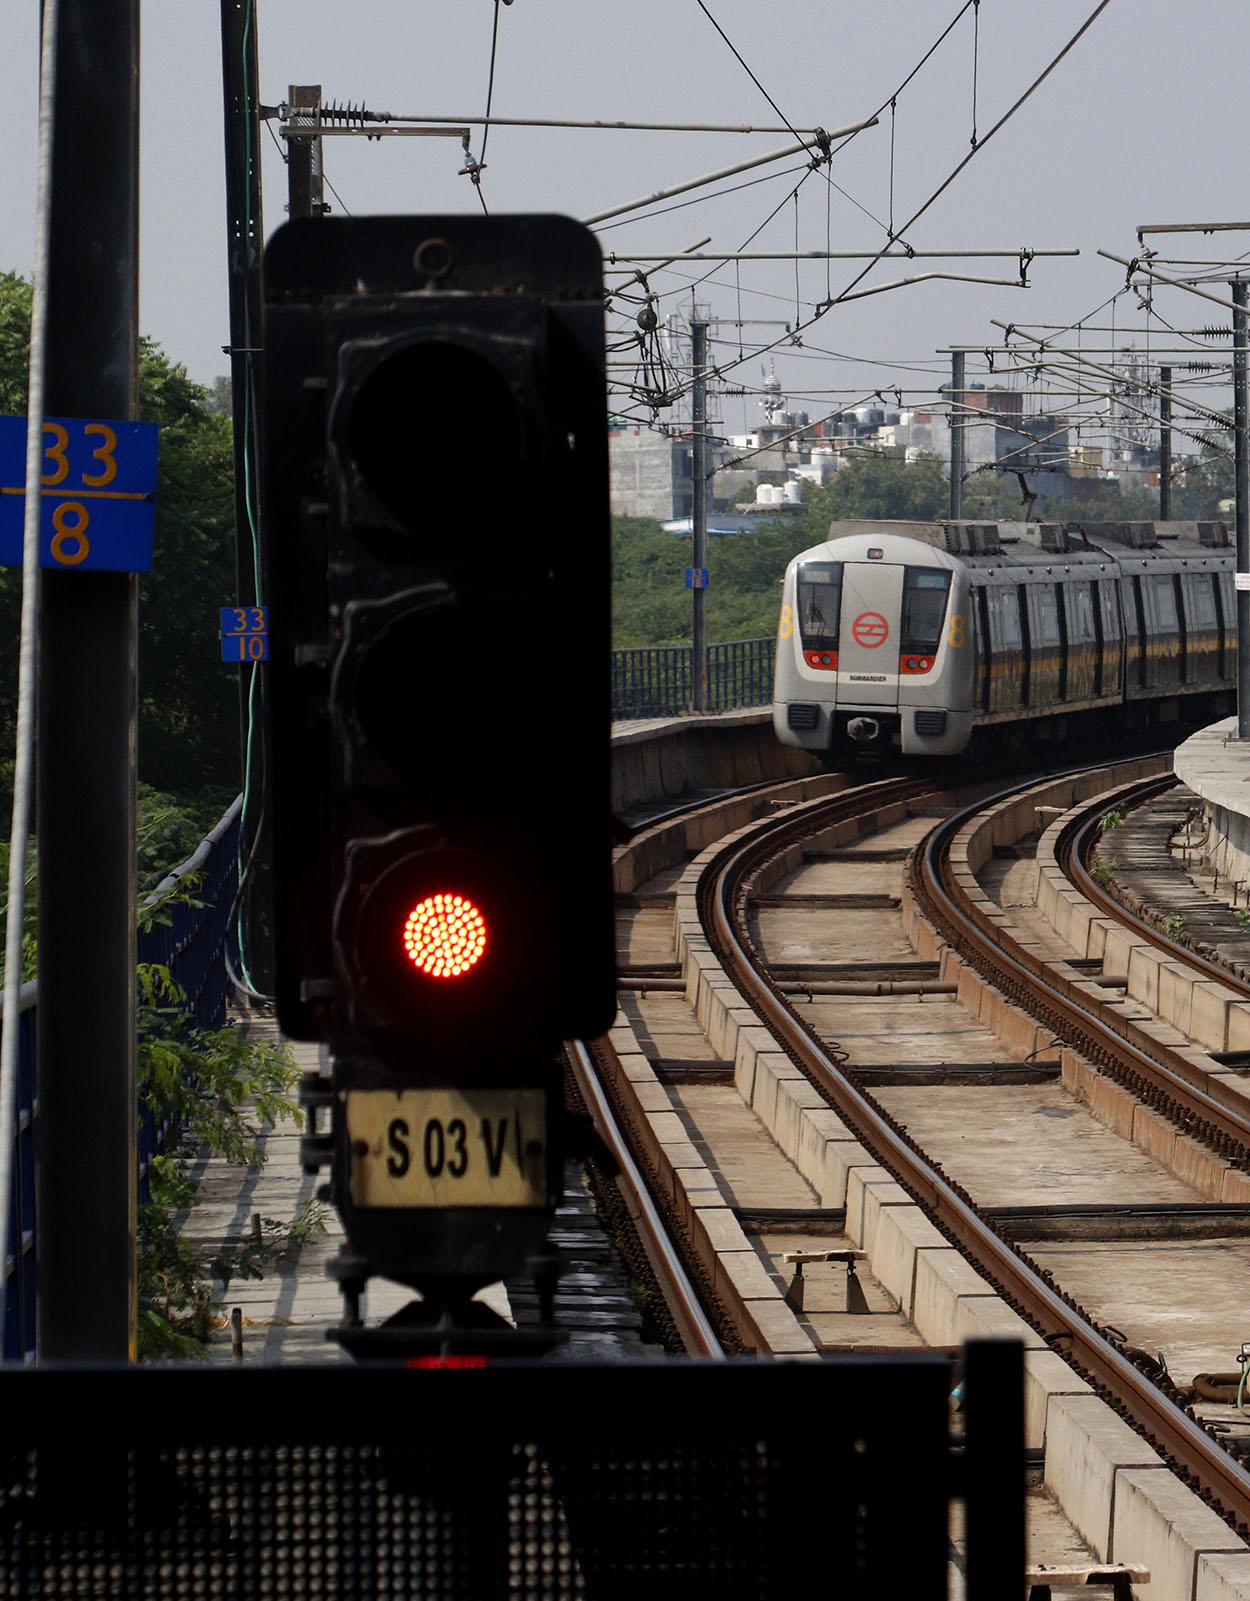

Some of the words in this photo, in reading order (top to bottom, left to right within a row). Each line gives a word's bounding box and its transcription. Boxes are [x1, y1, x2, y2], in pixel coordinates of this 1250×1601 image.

[40, 423, 117, 486] 33
[50, 501, 90, 565] 8
[233, 608, 265, 632] 33
[949, 614, 965, 648] 8
[239, 636, 264, 660] 10
[850, 674, 887, 683] BOMBARDIER
[387, 1118, 410, 1178] S
[424, 1118, 469, 1178] 03
[481, 1117, 509, 1177] V
